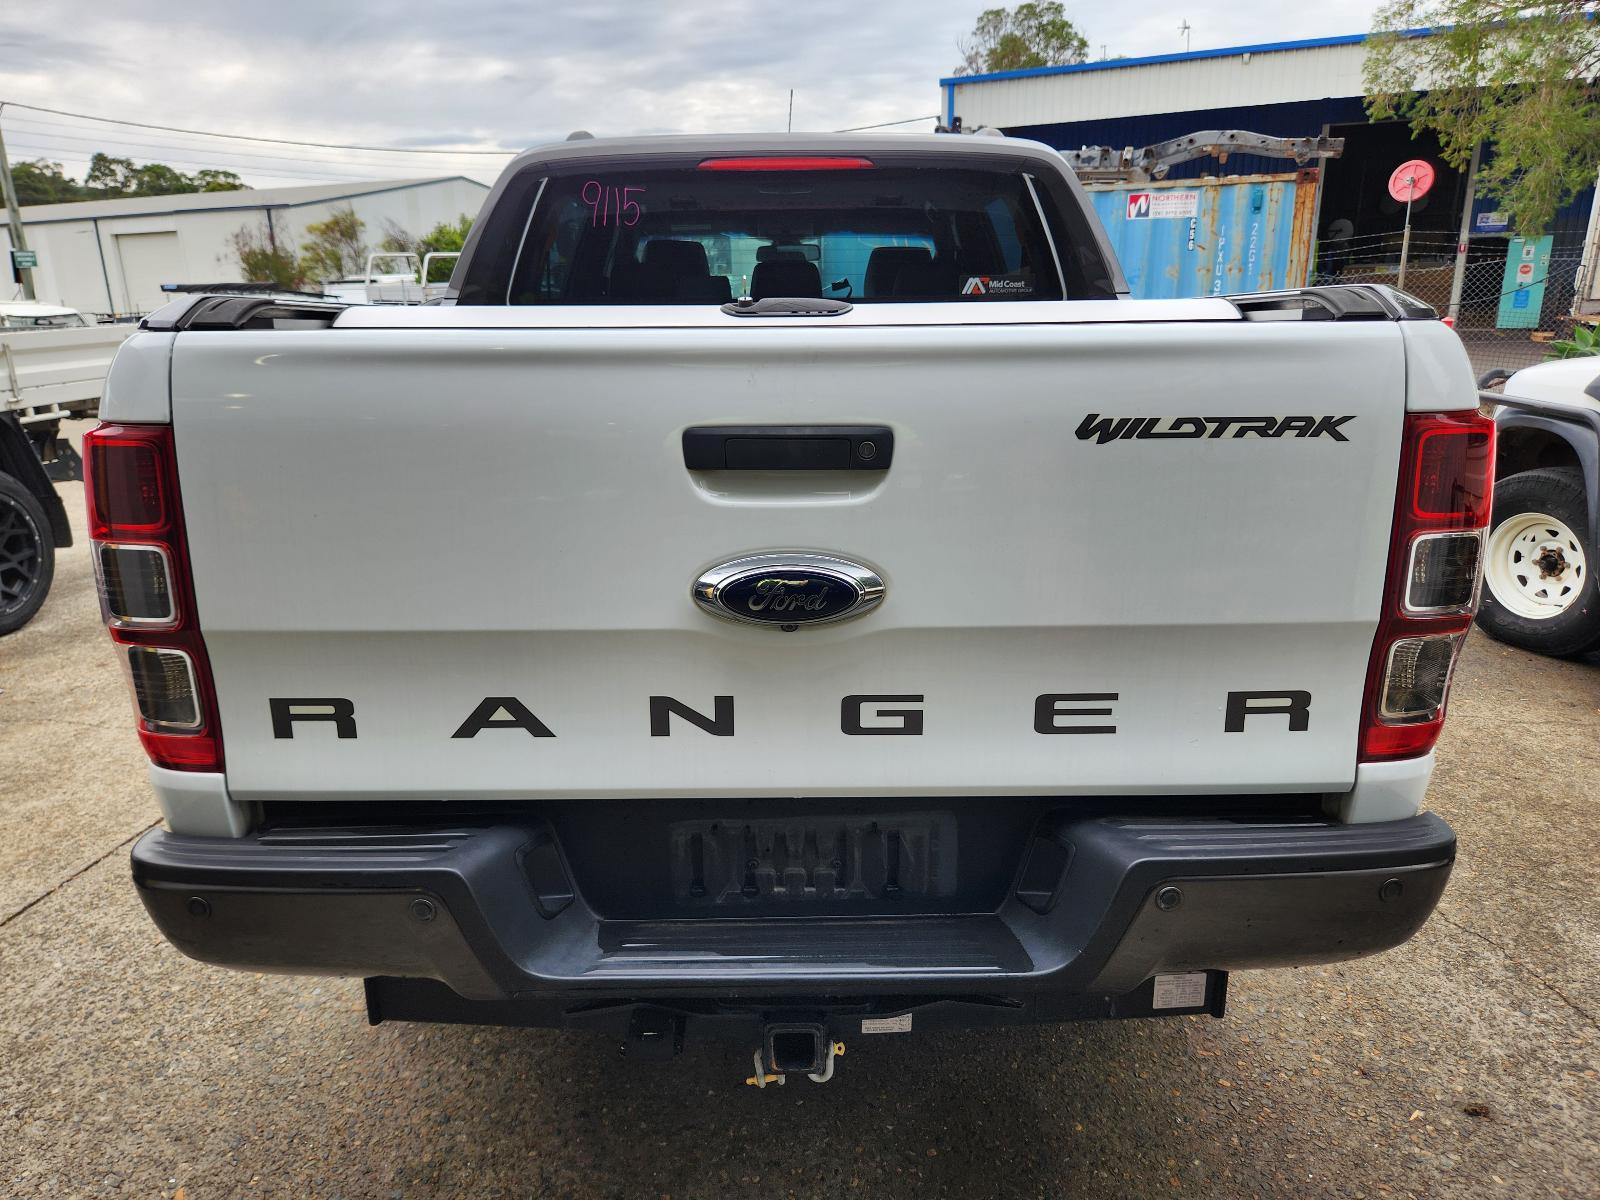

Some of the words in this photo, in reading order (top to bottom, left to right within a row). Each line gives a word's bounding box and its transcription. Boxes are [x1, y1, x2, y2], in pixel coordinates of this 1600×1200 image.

[582, 181, 646, 228] 9115
[988, 280, 1003, 288] Mid
[1004, 280, 1025, 288] Coast
[1075, 413, 1358, 445] WILDTRAK
[748, 578, 834, 611] Ford
[269, 690, 1312, 739] RANGER
